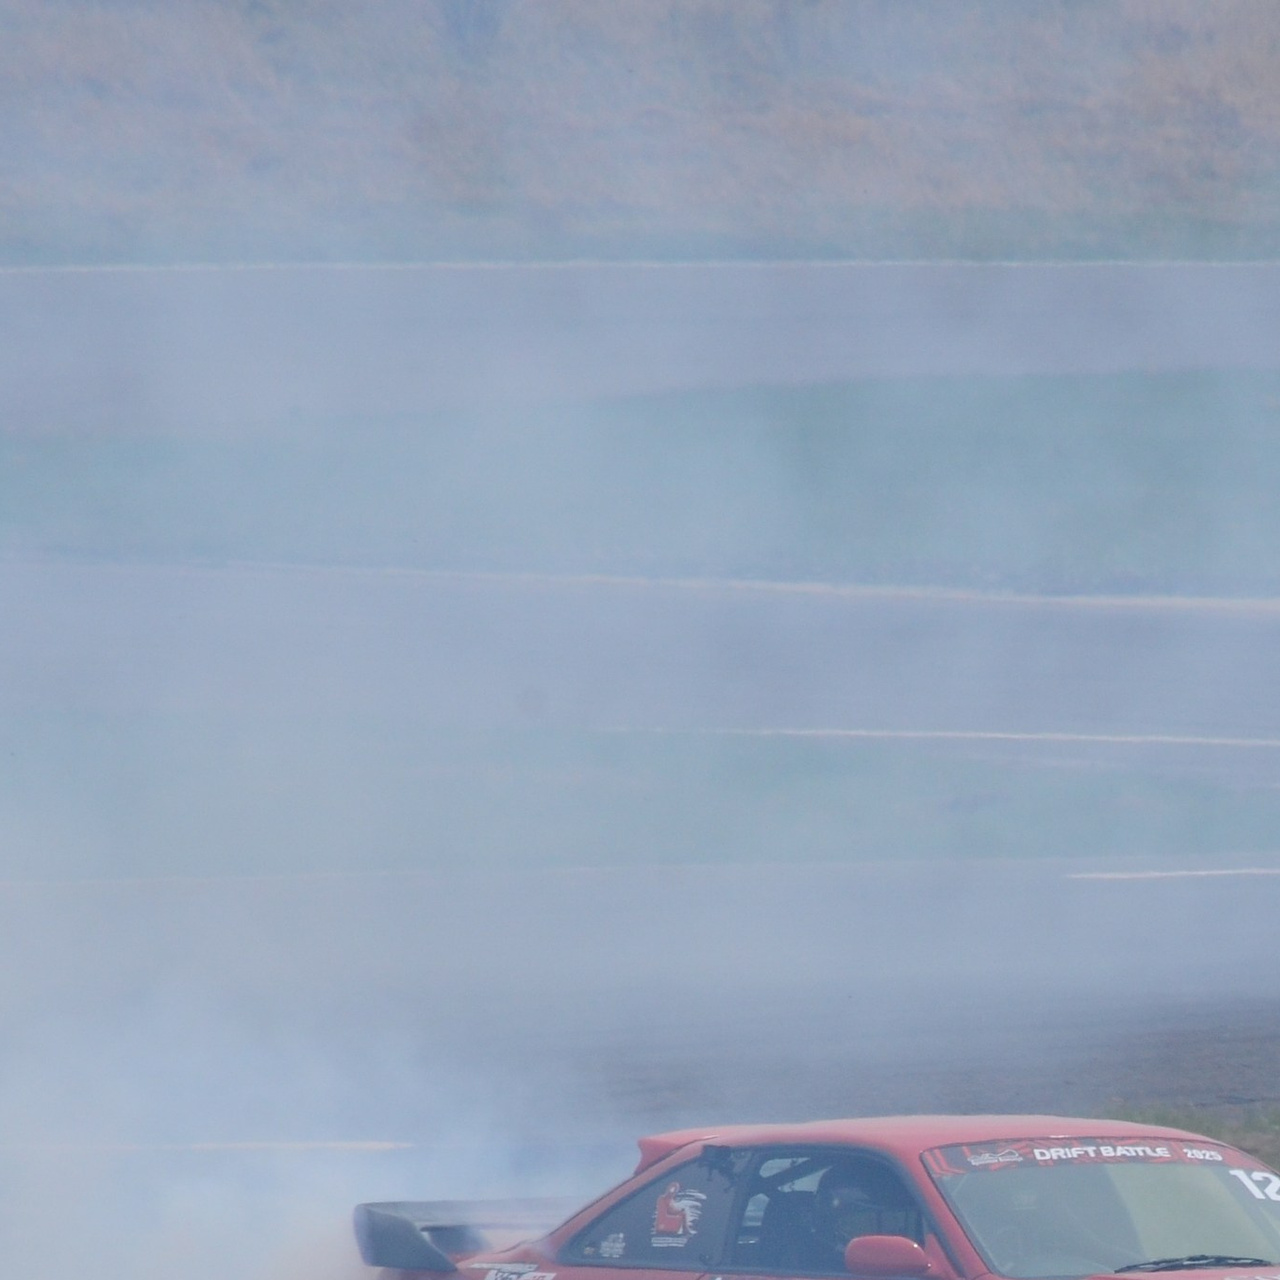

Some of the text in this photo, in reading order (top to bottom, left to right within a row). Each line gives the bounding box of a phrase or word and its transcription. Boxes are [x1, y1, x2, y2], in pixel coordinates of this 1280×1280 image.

[1033, 1145, 1224, 1162] DRIFT BATTLE 2025
